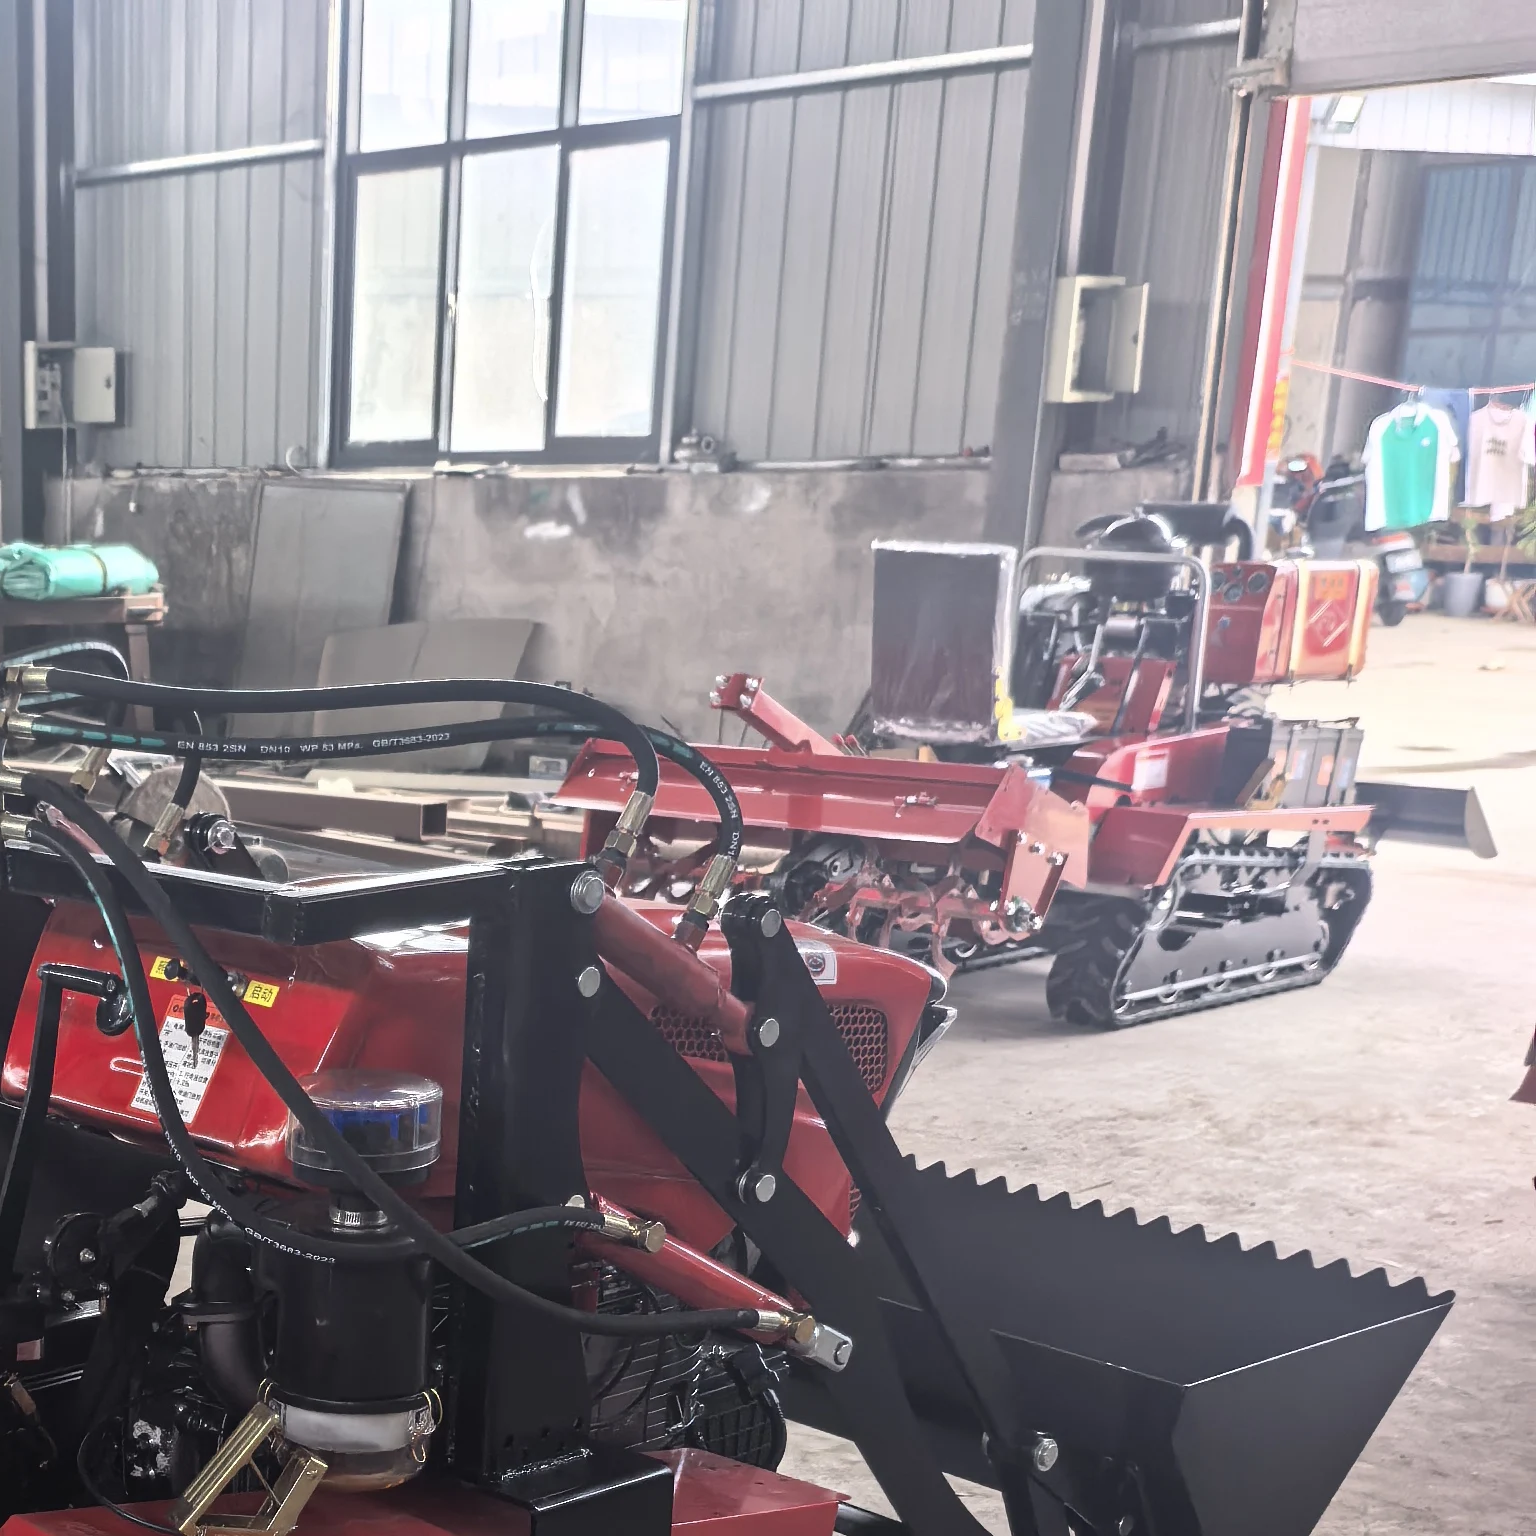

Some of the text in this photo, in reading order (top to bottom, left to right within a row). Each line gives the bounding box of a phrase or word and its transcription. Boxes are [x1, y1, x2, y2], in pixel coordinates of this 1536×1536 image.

[176, 740, 195, 750] EN
[198, 742, 219, 752] 853
[222, 743, 247, 753] 2SN
[260, 745, 291, 754] DN10
[299, 743, 319, 753] WP
[321, 743, 335, 752] 53
[372, 732, 451, 748] GB/T3683-2023
[699, 760, 714, 777] EN
[712, 774, 728, 795] 853
[724, 794, 739, 819] 2SN
[250, 983, 274, 1003] 启动
[164, 1131, 181, 1162] DN10
[185, 1166, 199, 1186] WP
[200, 1187, 211, 1201] 53
[244, 1226, 336, 1264] GB/T3683-2023
